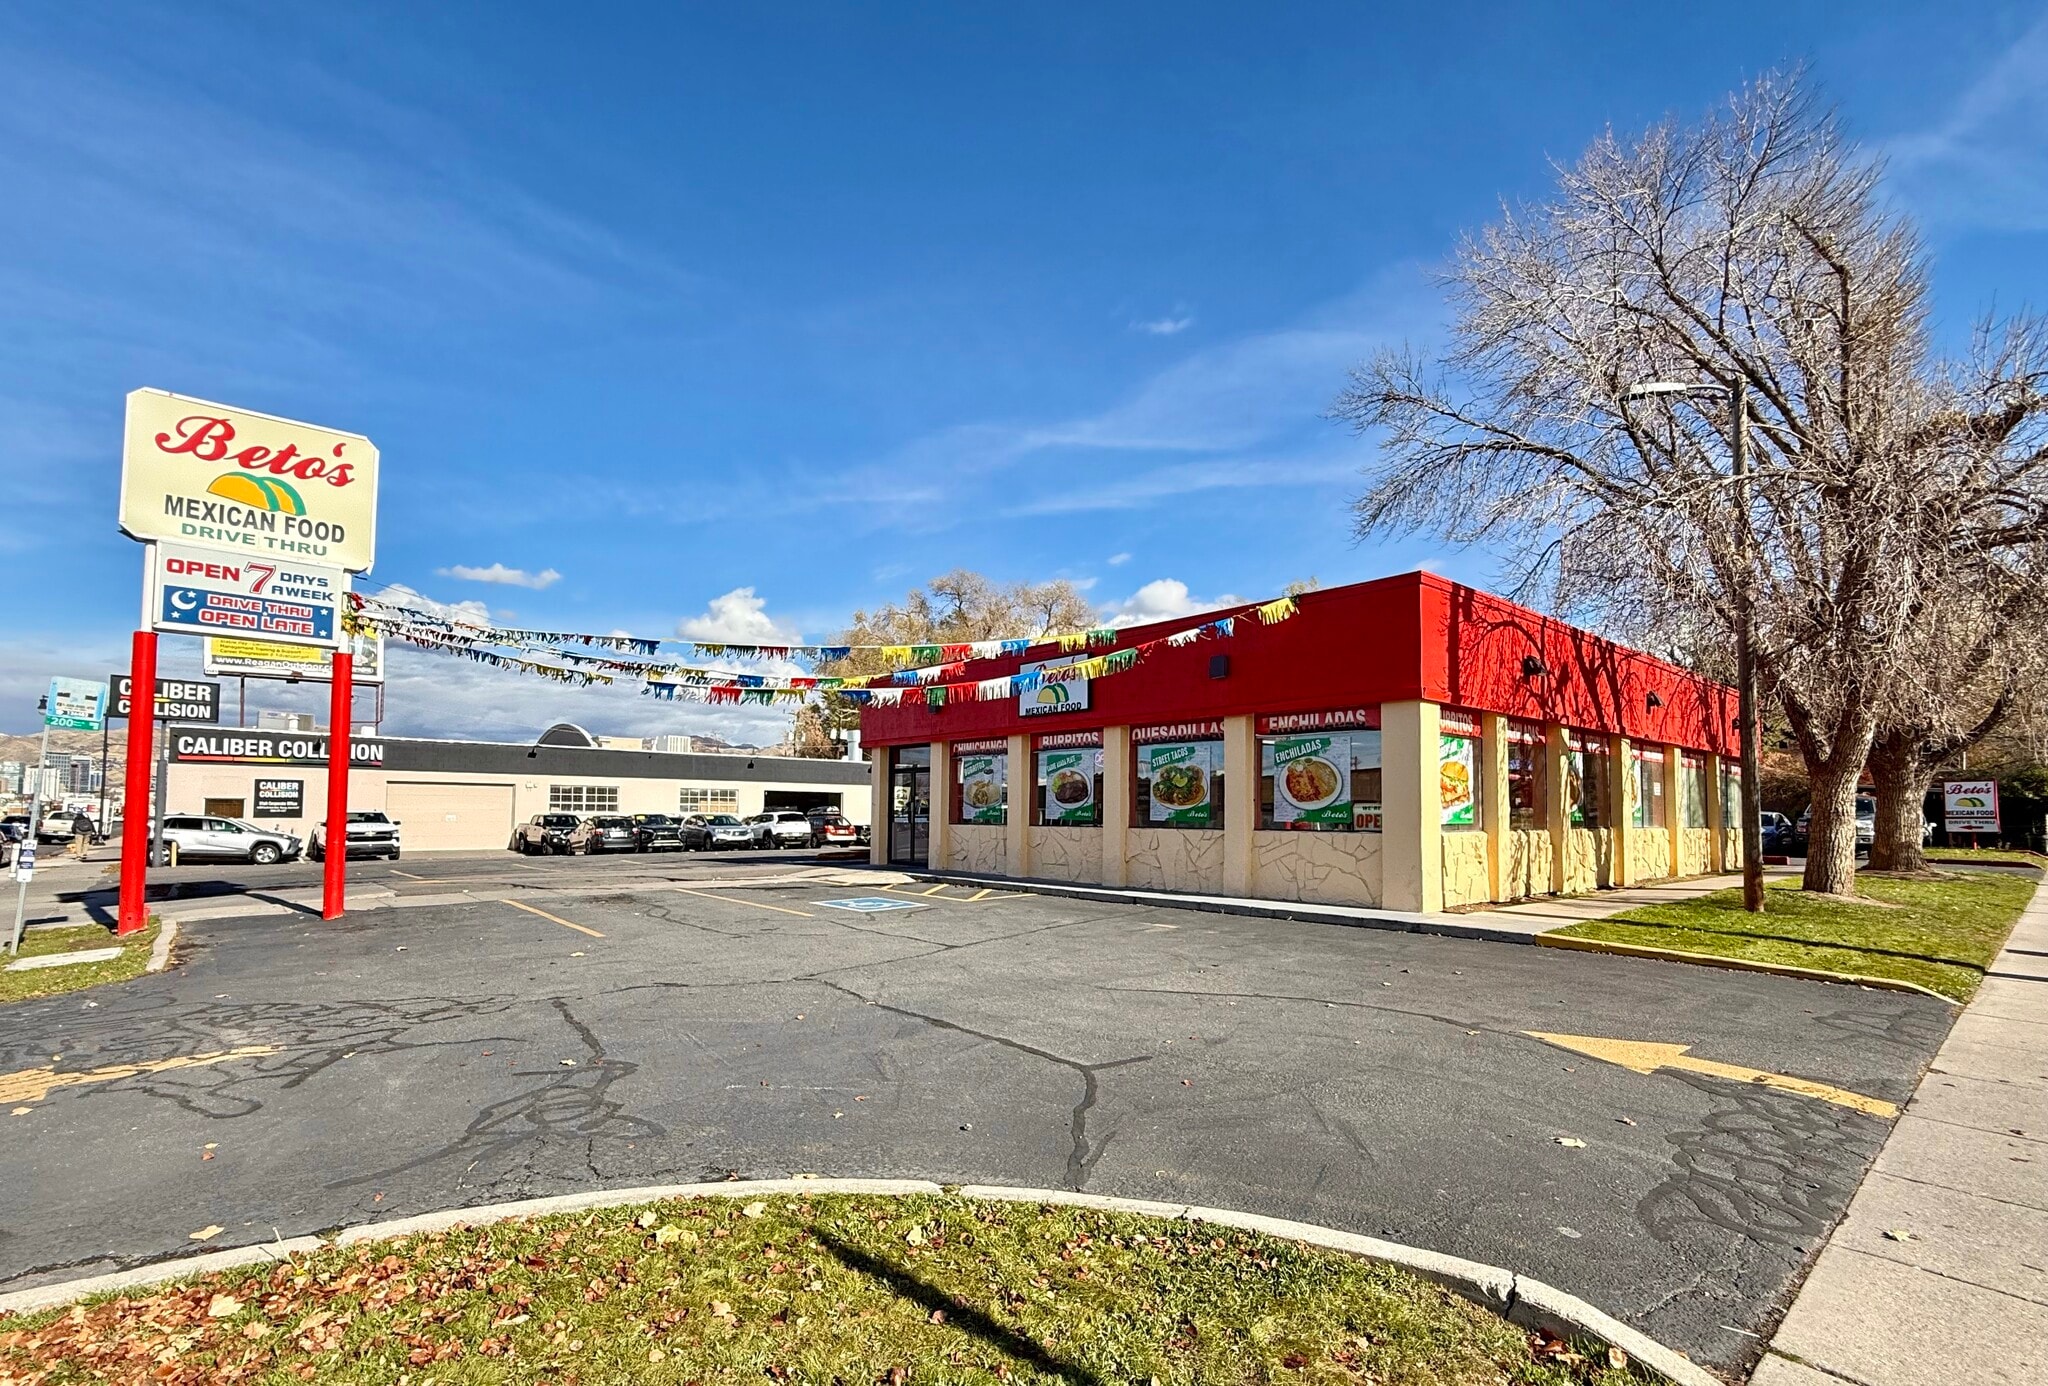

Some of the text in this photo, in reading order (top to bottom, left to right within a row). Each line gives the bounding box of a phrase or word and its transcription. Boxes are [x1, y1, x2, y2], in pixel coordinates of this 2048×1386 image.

[155, 416, 355, 487] Beto's
[164, 494, 345, 544] MEXICAN FOOD
[181, 523, 327, 556] DRIVE THRU
[166, 558, 329, 595] OPEN 7 DAYS
[271, 585, 334, 602] A WEEK
[209, 595, 313, 619] DRIVE THRU
[199, 610, 314, 634] OPEN LATE
[119, 678, 212, 701] CIBER
[117, 700, 211, 719] CLISION
[1025, 702, 1082, 715] MEXICAN FOOD
[50, 717, 74, 727] 200
[1268, 709, 1367, 732] ENCHILADAS
[177, 736, 384, 761] CALIBER COLLION
[1152, 747, 1189, 767] STREET TACOS
[1275, 739, 1322, 763] ENCHILADAS
[259, 781, 299, 790] CALIBER
[259, 790, 299, 798] COLLISION
[1946, 783, 1992, 795] Beto's
